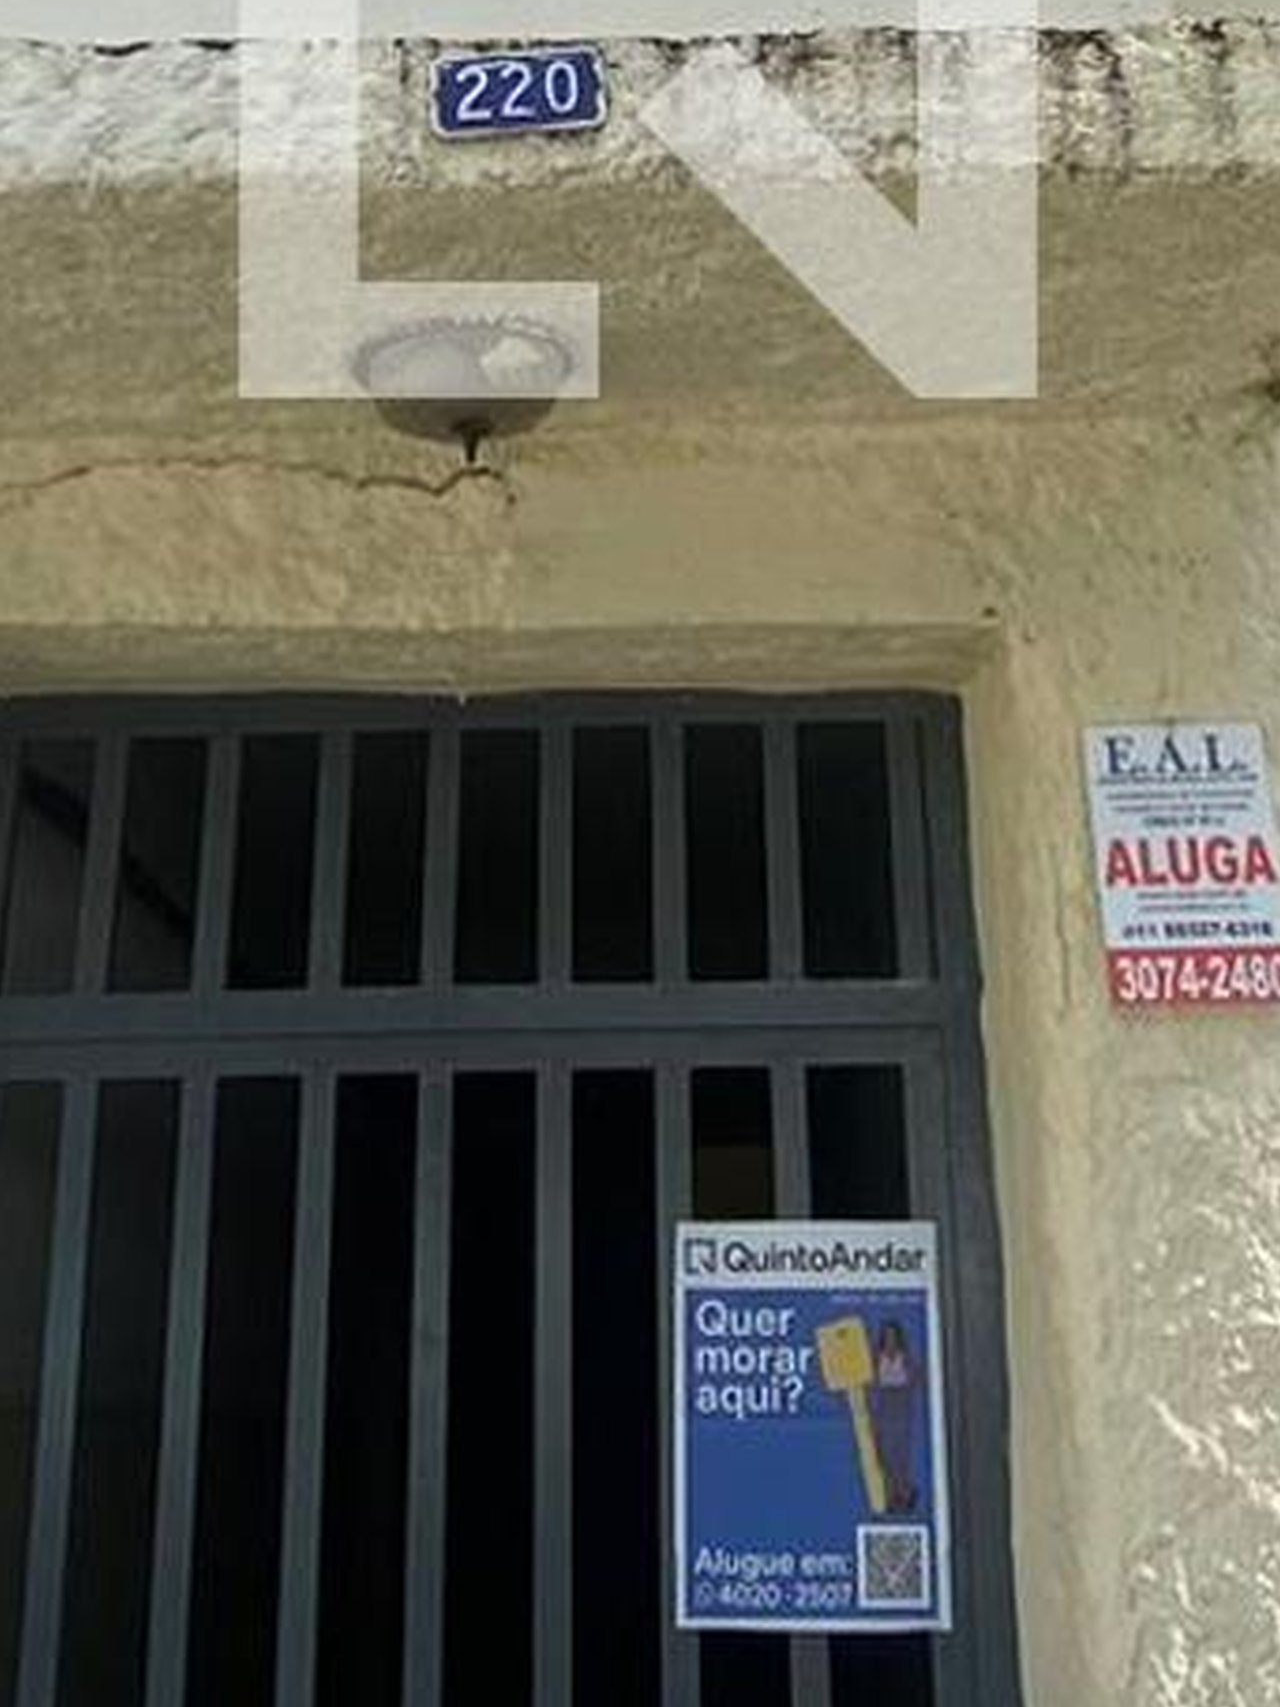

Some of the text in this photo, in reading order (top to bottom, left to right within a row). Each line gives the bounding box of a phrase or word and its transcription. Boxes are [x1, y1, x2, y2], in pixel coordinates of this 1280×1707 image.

[455, 60, 579, 121] 220
[1106, 836, 1278, 886] ALUGA
[723, 1241, 927, 1274] QuintoAndar
[696, 1300, 795, 1338] Quer
[696, 1344, 812, 1375] morar
[696, 1377, 804, 1419] aqui?
[695, 1547, 854, 1581] Alugue em:
